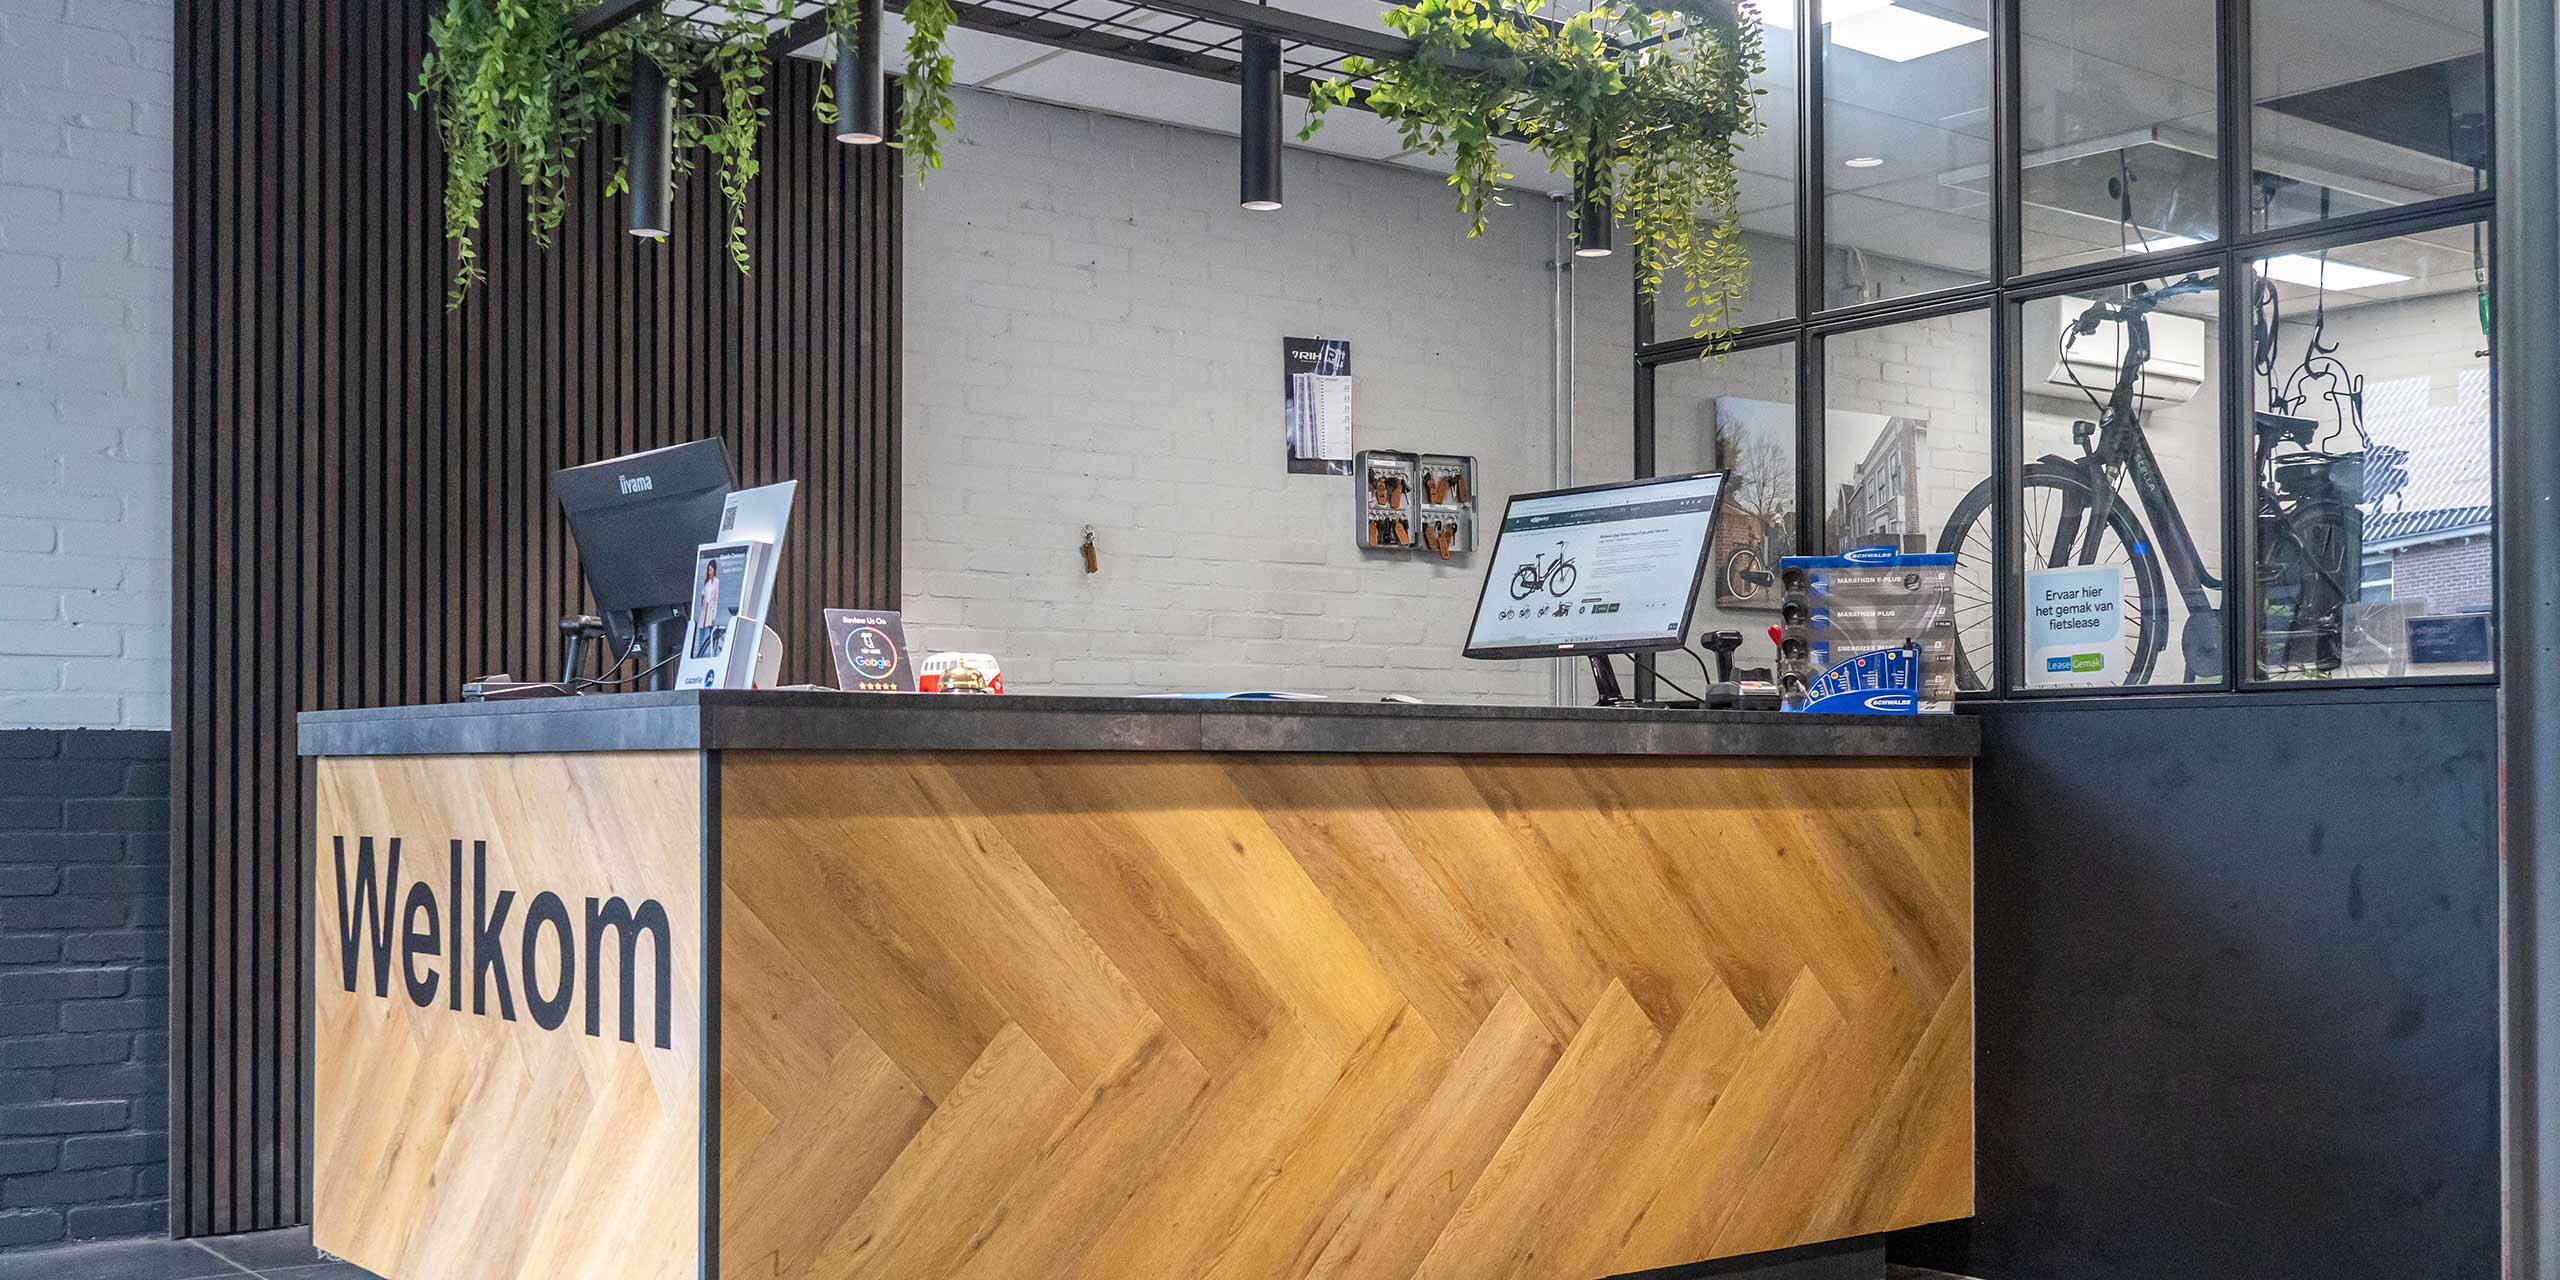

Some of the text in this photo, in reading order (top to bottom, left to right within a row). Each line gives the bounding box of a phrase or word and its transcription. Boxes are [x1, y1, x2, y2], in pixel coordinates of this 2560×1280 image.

[618, 474, 653, 495] iiyama
[2045, 586, 2103, 601] Ervaar hier
[2035, 602, 2114, 618] het gemak van
[866, 617, 875, 625] Us
[875, 617, 887, 625] On
[2049, 618, 2100, 631] fietslease
[855, 656, 891, 669] Google
[333, 836, 671, 1050] Welkom
